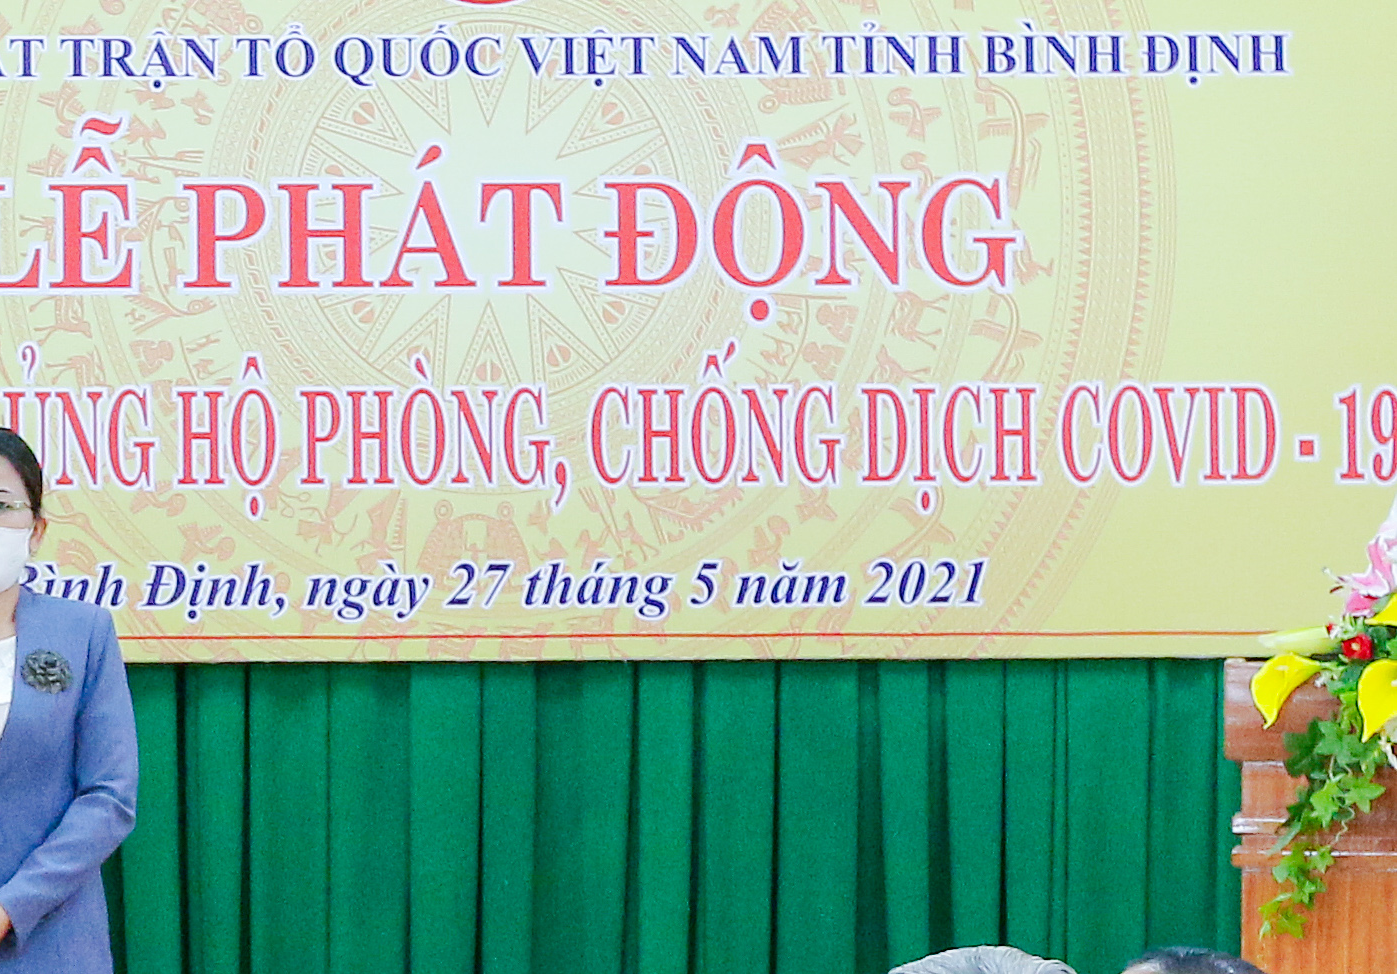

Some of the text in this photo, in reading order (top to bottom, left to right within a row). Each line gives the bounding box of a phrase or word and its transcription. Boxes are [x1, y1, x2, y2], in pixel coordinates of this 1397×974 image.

[59, 29, 219, 90] TRẬN
[235, 22, 315, 79] TỔ
[333, 20, 502, 88] QUỐC
[521, 27, 653, 87] VIỆT
[673, 35, 804, 75] NAM
[822, 21, 963, 75] TỈNH
[984, 21, 1122, 75] BÌNH
[1141, 34, 1288, 85] ĐỊNH
[182, 145, 563, 290] PHÁT
[603, 143, 1017, 322] ĐỘNG
[3, 344, 155, 487] ỦNG
[177, 356, 276, 515] HỘ
[300, 358, 570, 505] PHÒNG,
[590, 342, 841, 485] CHỐNG
[862, 385, 1037, 511] DỊCH
[1061, 384, 1277, 483] COVID
[1339, 388, 1397, 482] 19
[140, 563, 288, 620] Định,
[306, 562, 431, 621] ngày
[448, 562, 510, 607] 27
[522, 561, 672, 617] tháng
[690, 562, 719, 606] 5
[735, 562, 847, 605] năm
[865, 561, 986, 605] 2021
